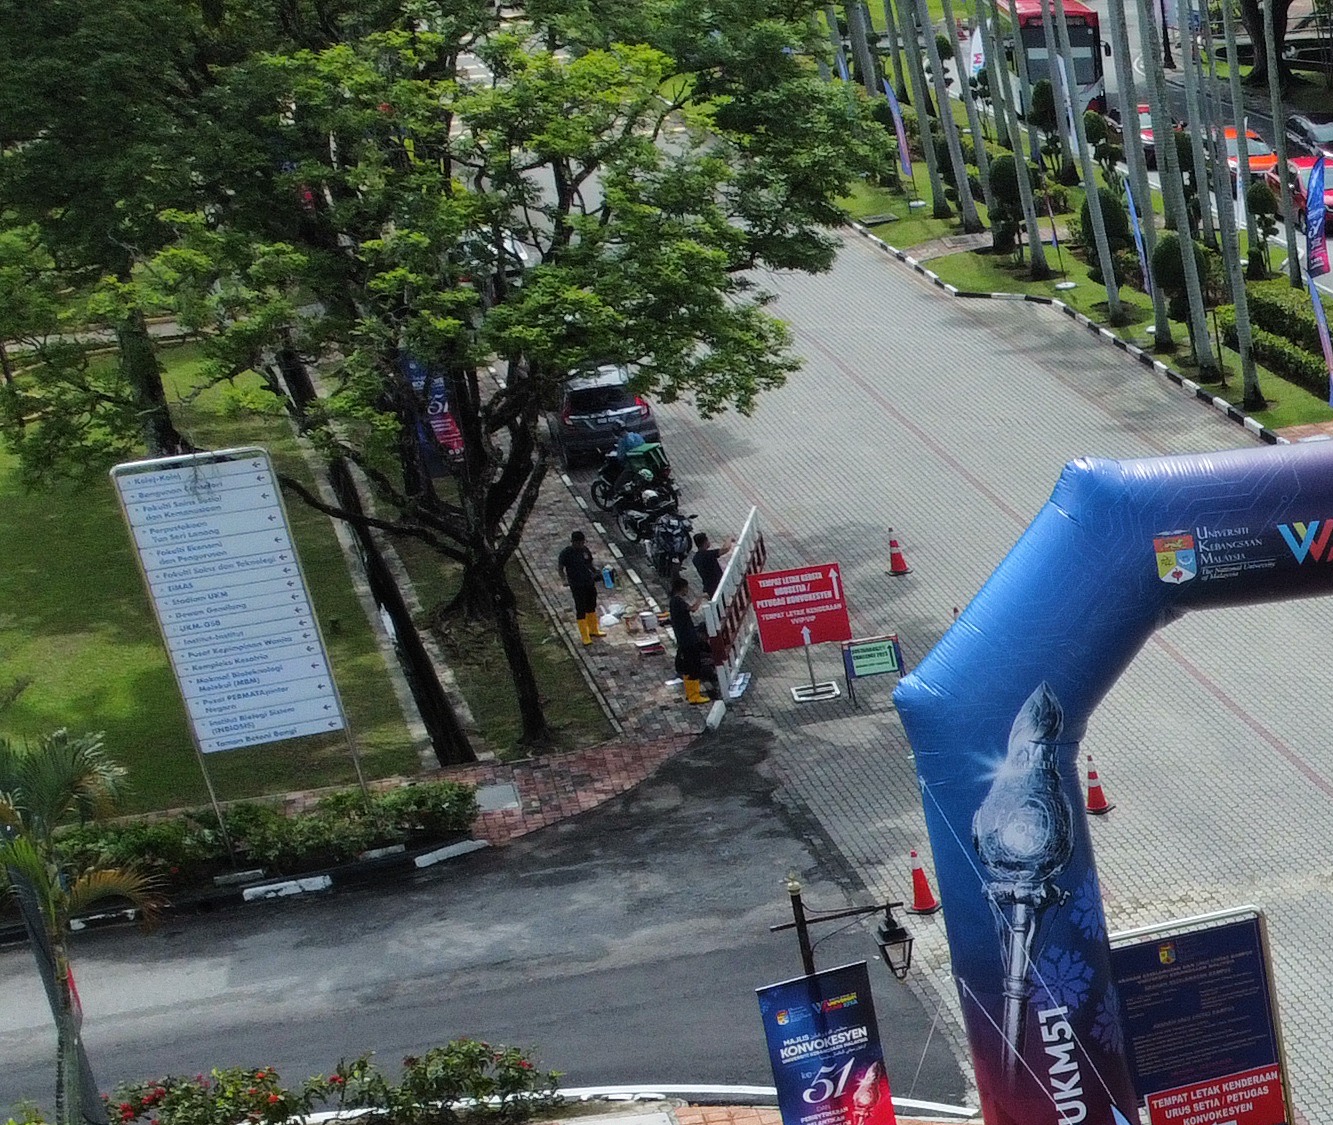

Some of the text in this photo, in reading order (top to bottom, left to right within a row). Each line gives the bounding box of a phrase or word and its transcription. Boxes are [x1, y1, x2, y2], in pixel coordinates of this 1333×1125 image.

[779, 1026, 868, 1059] KONVOKESYEN
[782, 1034, 810, 1047] MAJLIS
[802, 1057, 856, 1104] 51
[1152, 1071, 1279, 1110] TEMPAT LETAK KENDERAAN
[1165, 1105, 1191, 1119] URUS
[1193, 1098, 1220, 1112] SETIA
[1226, 1085, 1270, 1104] PETUGAS
